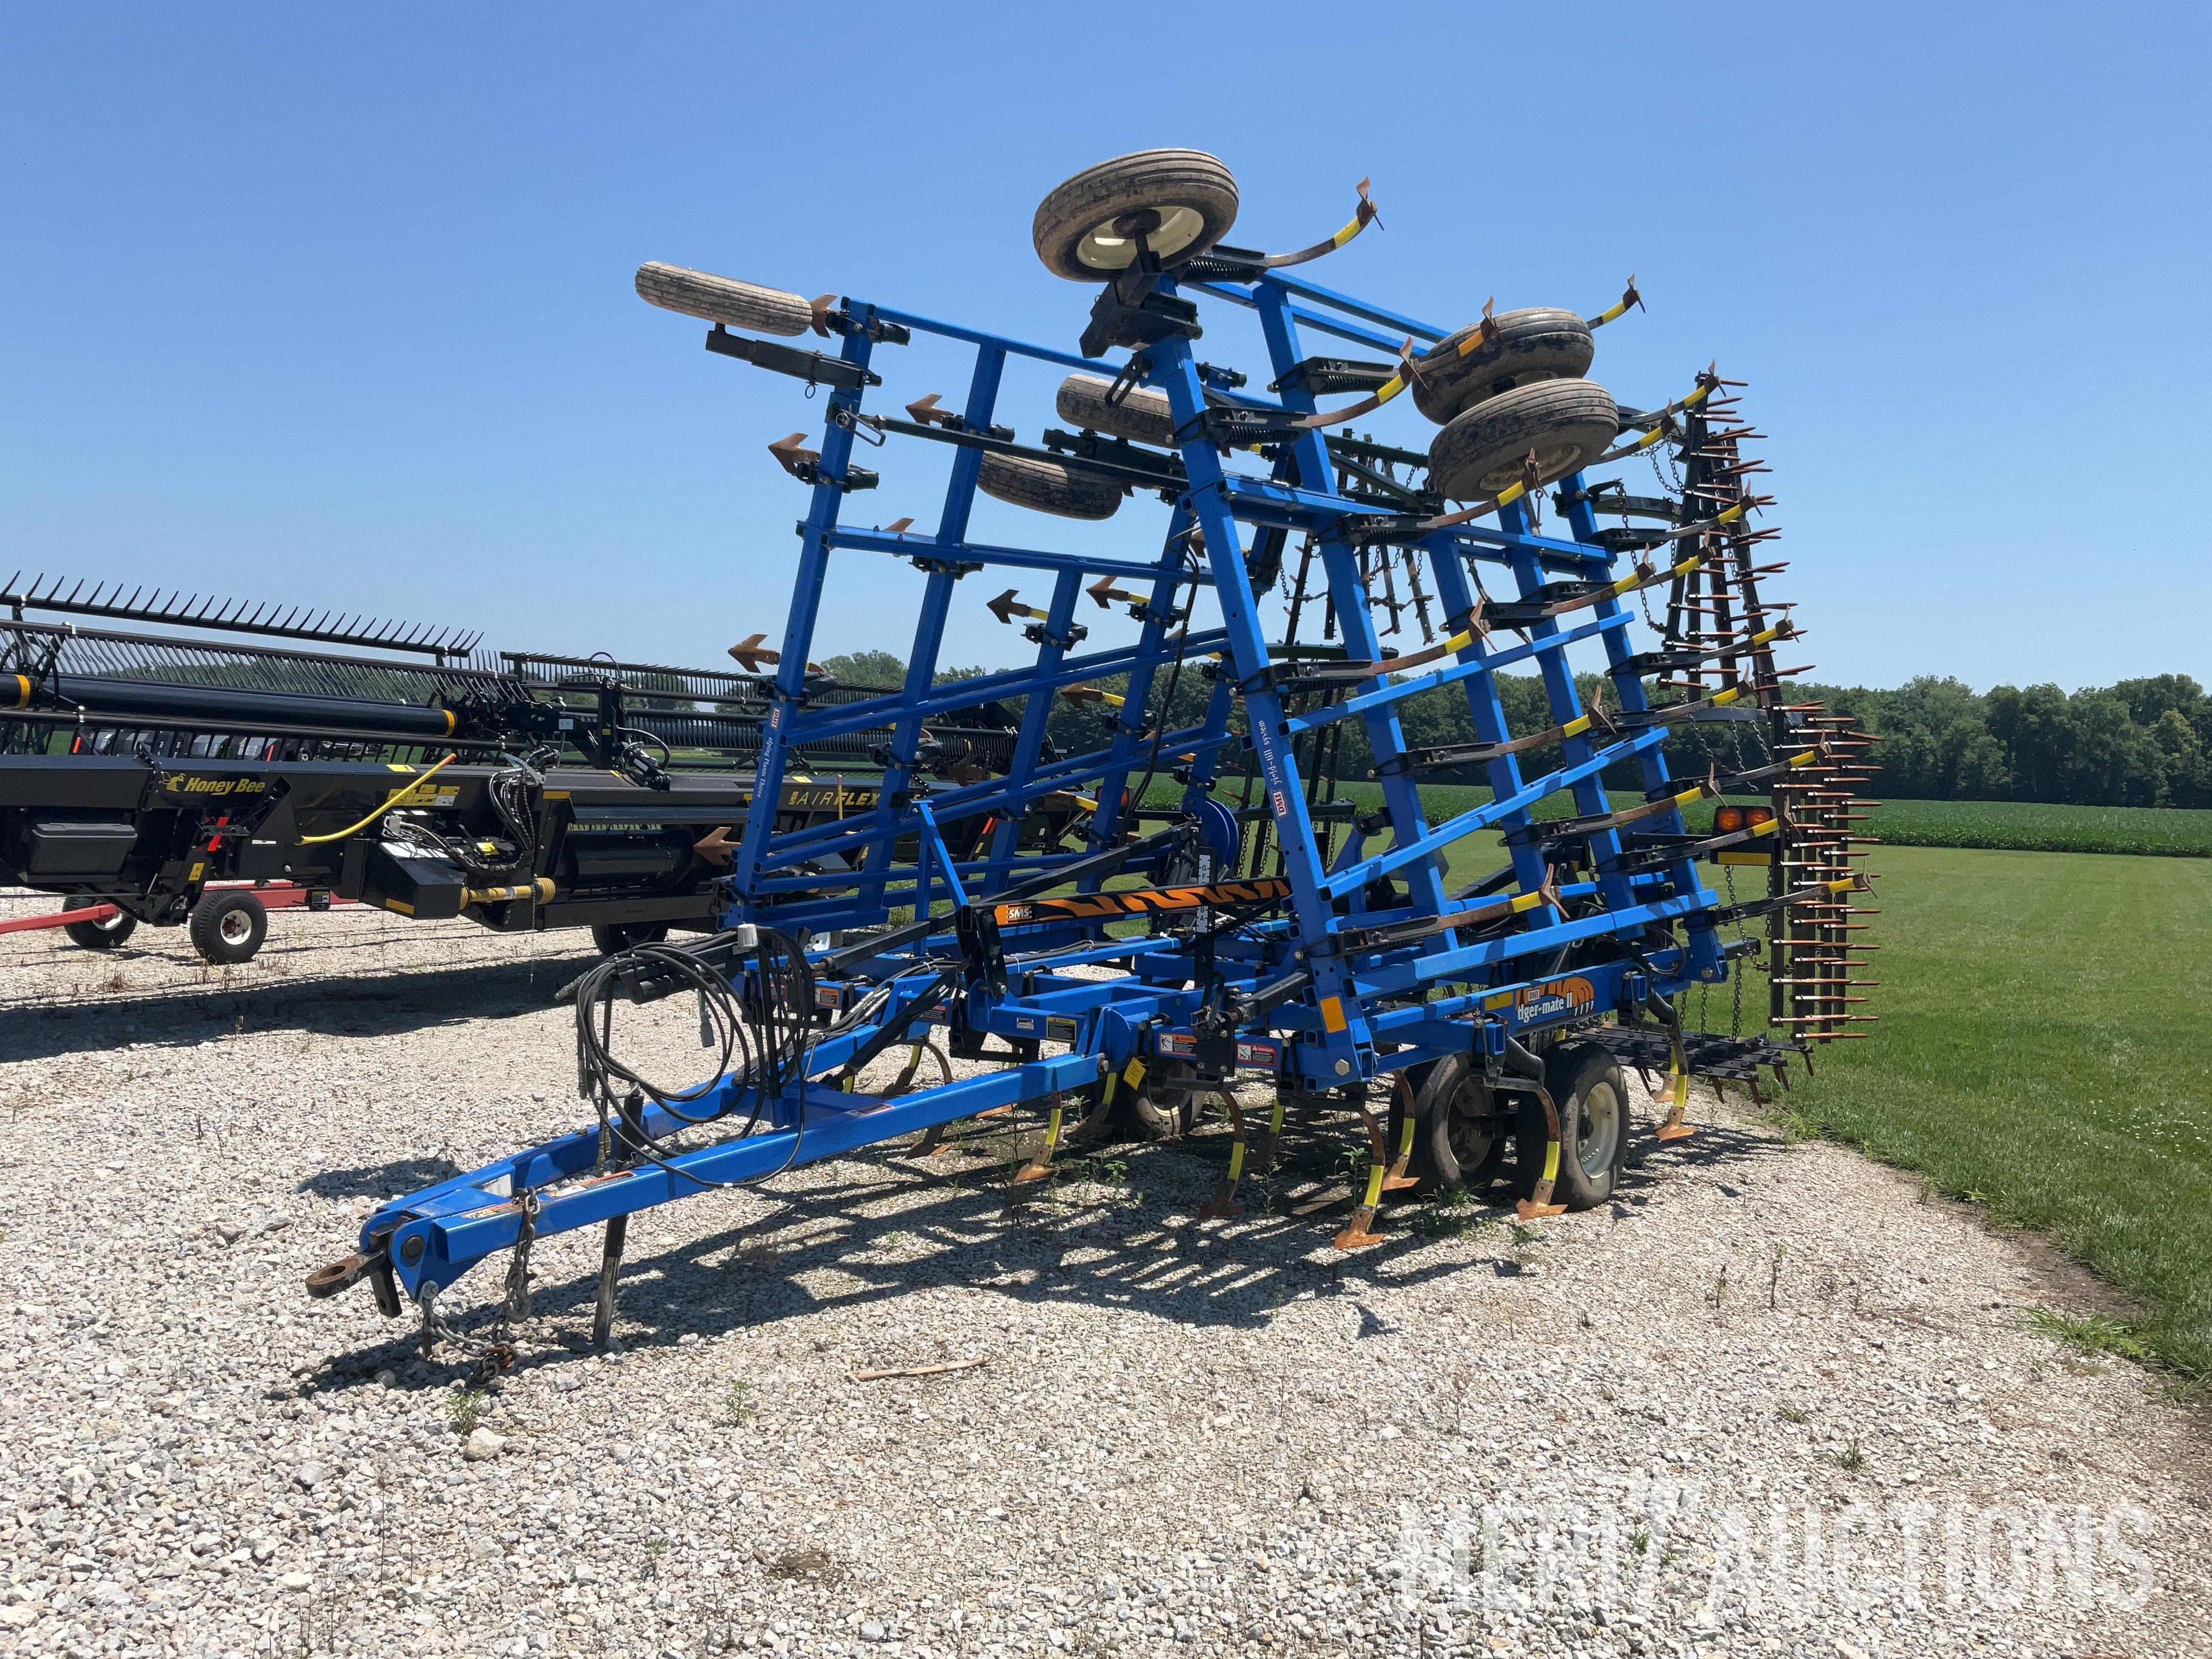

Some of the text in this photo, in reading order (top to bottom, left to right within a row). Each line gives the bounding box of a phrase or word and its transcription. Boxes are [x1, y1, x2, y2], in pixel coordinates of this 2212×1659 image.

[1259, 720, 1271, 746] system
[761, 758, 770, 776] Plants
[183, 777, 266, 795] Honey Bee
[757, 778, 765, 798] Thrive
[1275, 794, 1285, 814] DMI
[1009, 909, 1030, 918] SMS
[1529, 990, 1539, 1000] DMI
[1517, 996, 1564, 1023] tiger-mate
